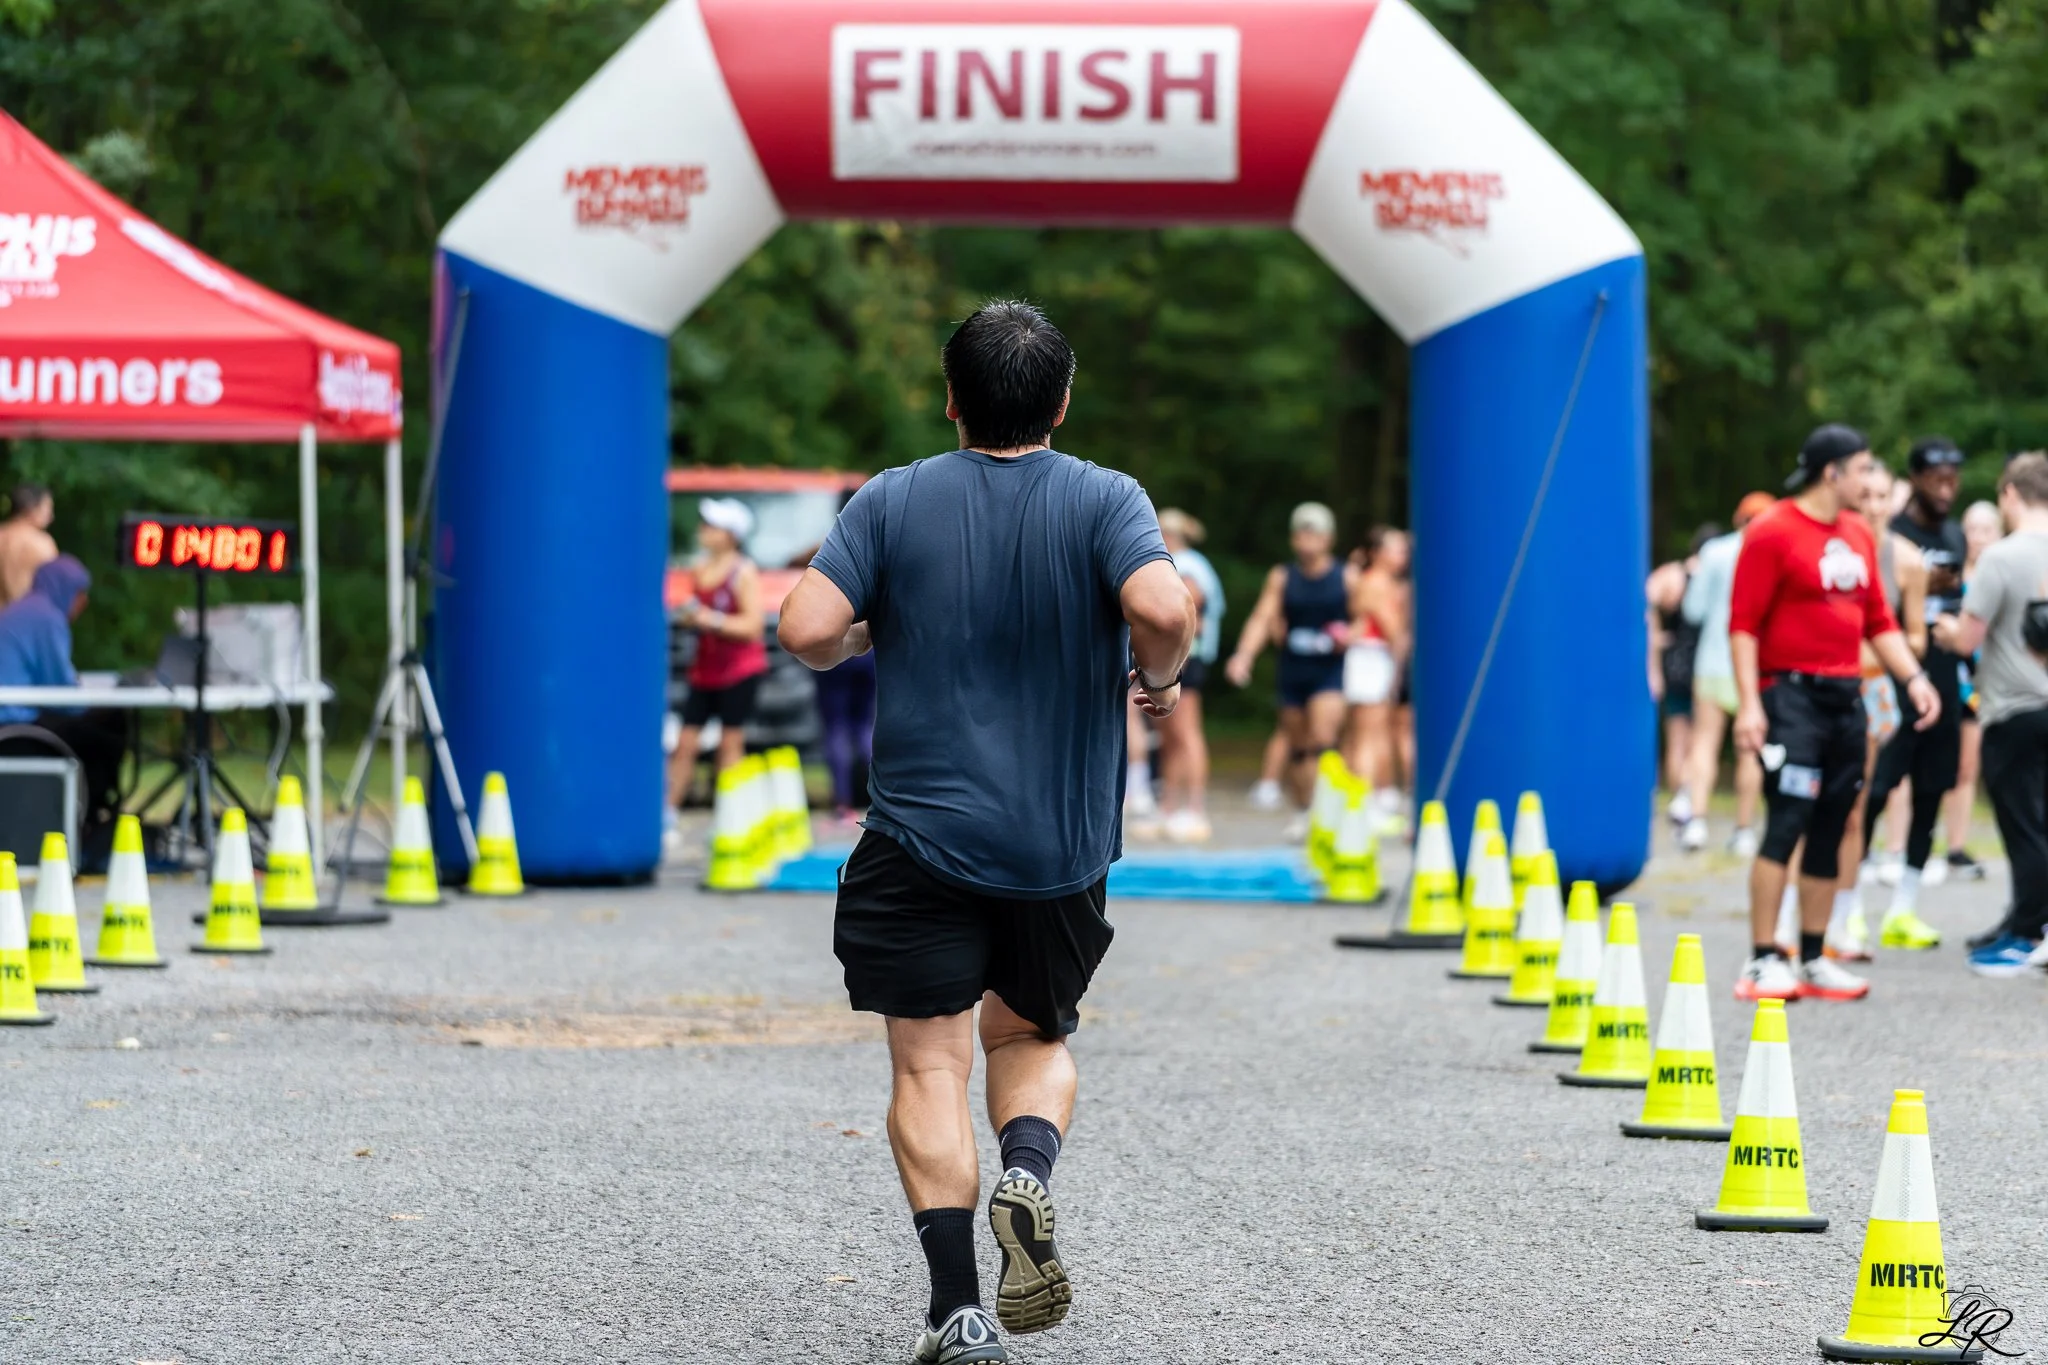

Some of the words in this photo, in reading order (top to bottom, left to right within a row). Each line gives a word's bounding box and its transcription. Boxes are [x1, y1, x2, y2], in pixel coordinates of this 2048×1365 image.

[852, 50, 1217, 121] FINISH
[0, 357, 223, 405] unners
[0, 963, 25, 980] TC
[1598, 1023, 1648, 1039] MRTC
[1658, 1066, 1715, 1085] MRTC
[1733, 1145, 1799, 1169] MRTC
[1870, 1263, 1944, 1290] MRTC
